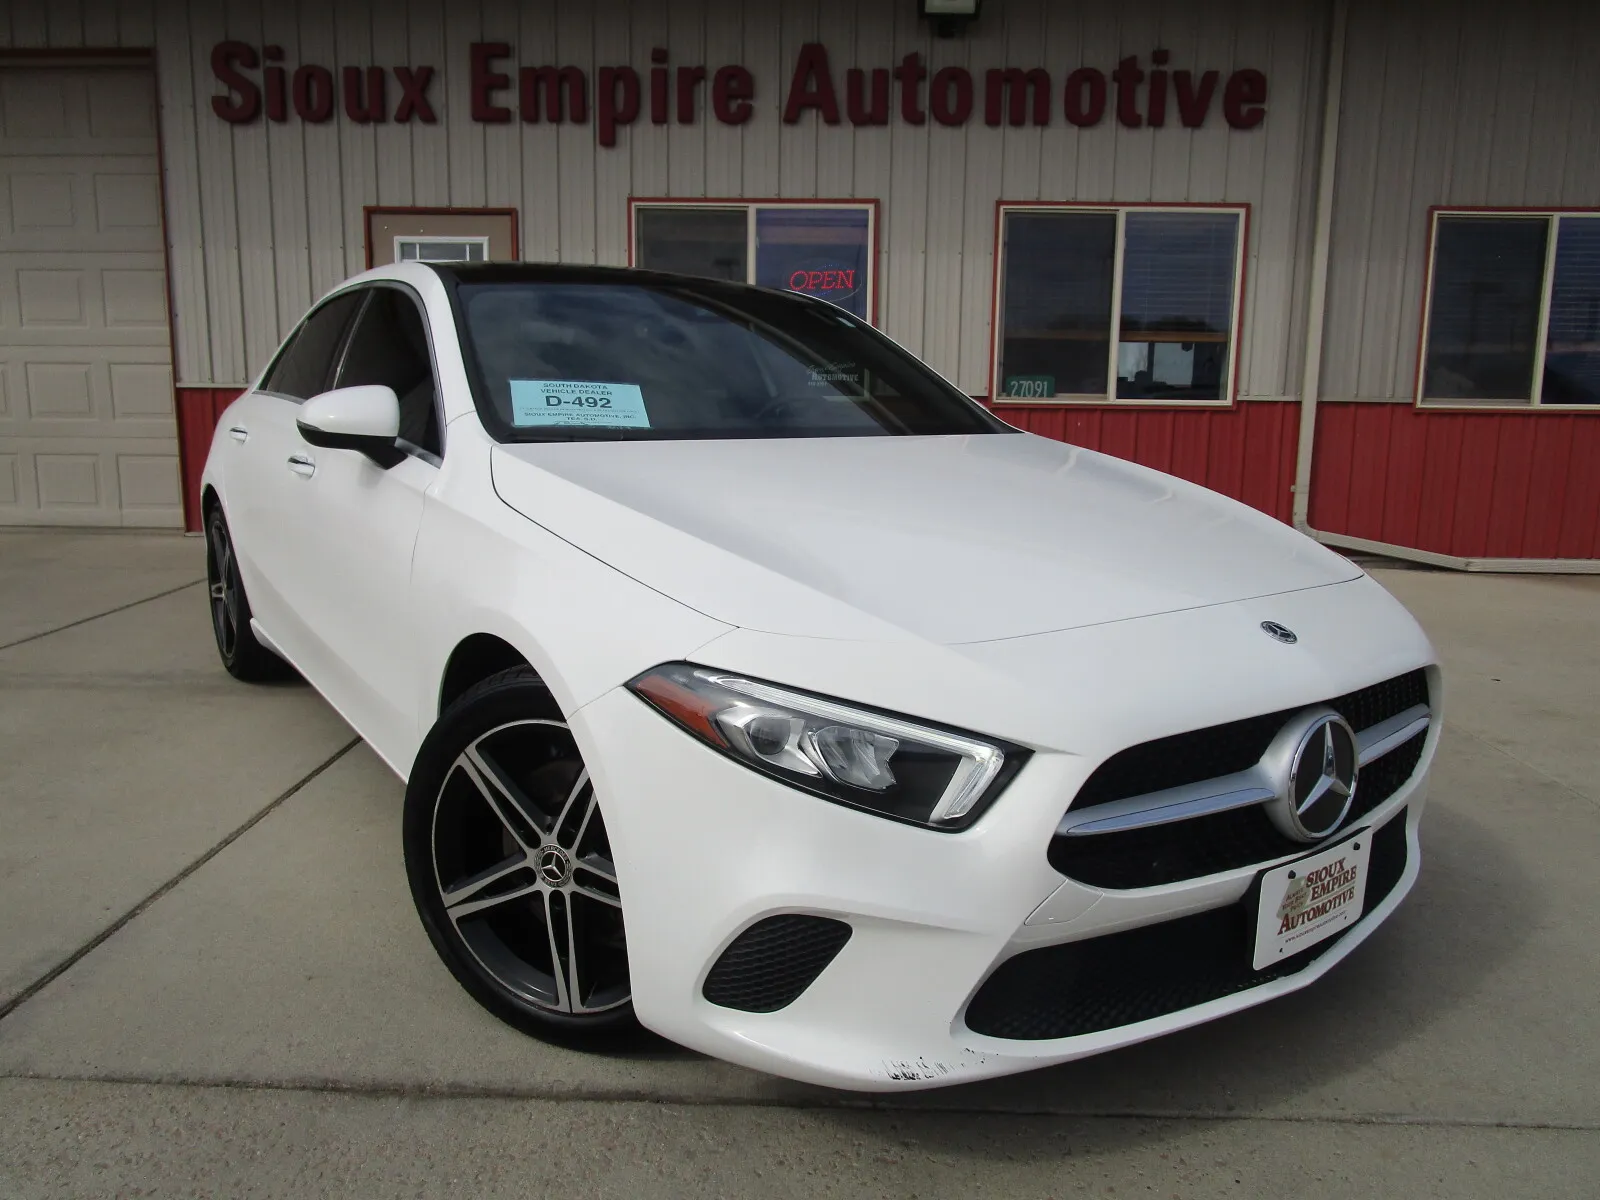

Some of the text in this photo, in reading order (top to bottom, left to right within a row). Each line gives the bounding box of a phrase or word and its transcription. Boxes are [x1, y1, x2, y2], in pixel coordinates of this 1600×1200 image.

[210, 40, 1268, 148] Sioux Empire Automotive
[789, 269, 855, 290] OPEN
[545, 395, 613, 408] D-492
[1010, 380, 1048, 398] 27091
[1306, 857, 1346, 888] SIOUX
[1311, 865, 1357, 902] EMPIRE
[1277, 886, 1355, 936] AUTOMOTIVE
